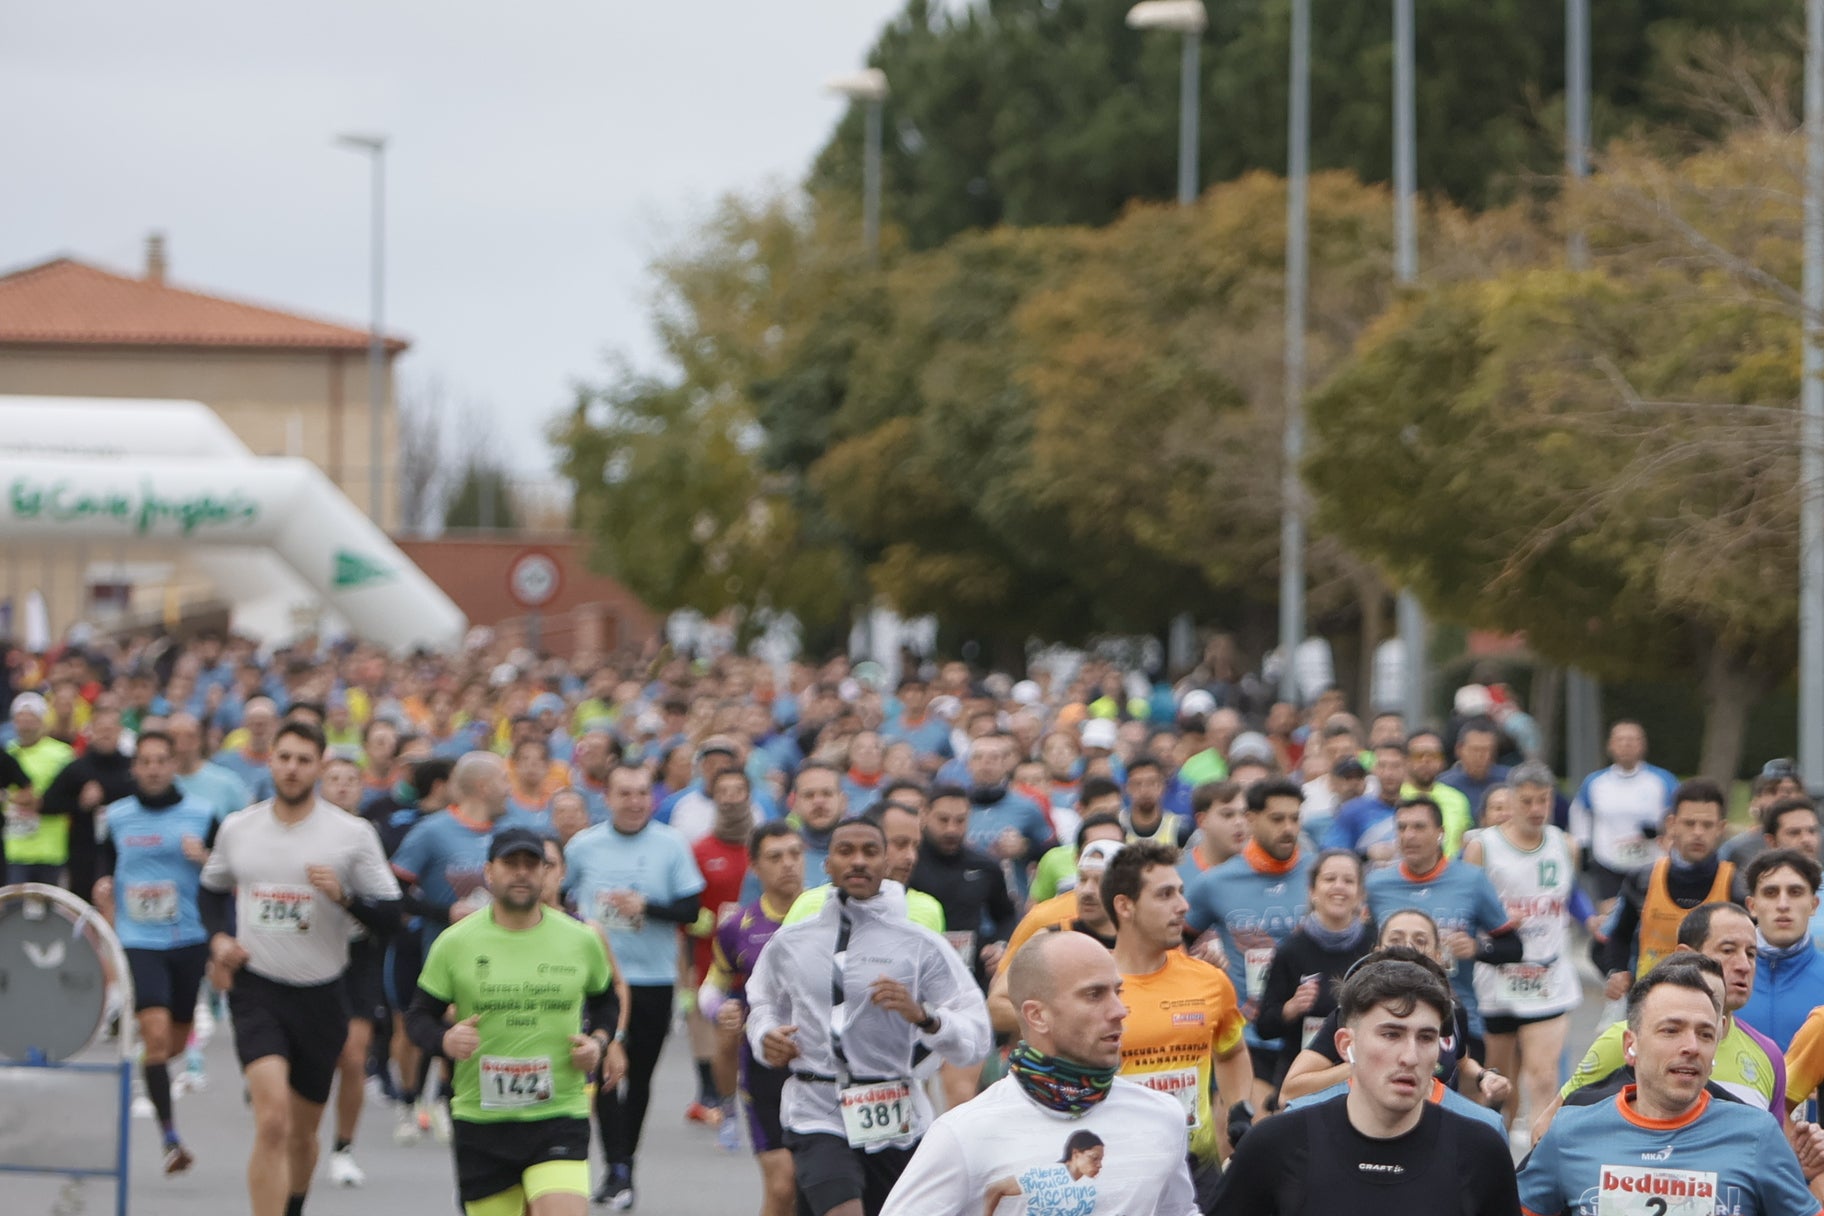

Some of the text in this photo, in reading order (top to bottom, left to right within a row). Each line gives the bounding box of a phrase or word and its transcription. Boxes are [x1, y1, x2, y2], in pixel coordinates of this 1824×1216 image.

[493, 1073, 538, 1095] 142
[858, 1102, 902, 1130] 381
[1358, 1162, 1393, 1173] CRAFT
[1641, 1153, 1663, 1161] MKA
[1602, 1171, 1713, 1198] bedunia
